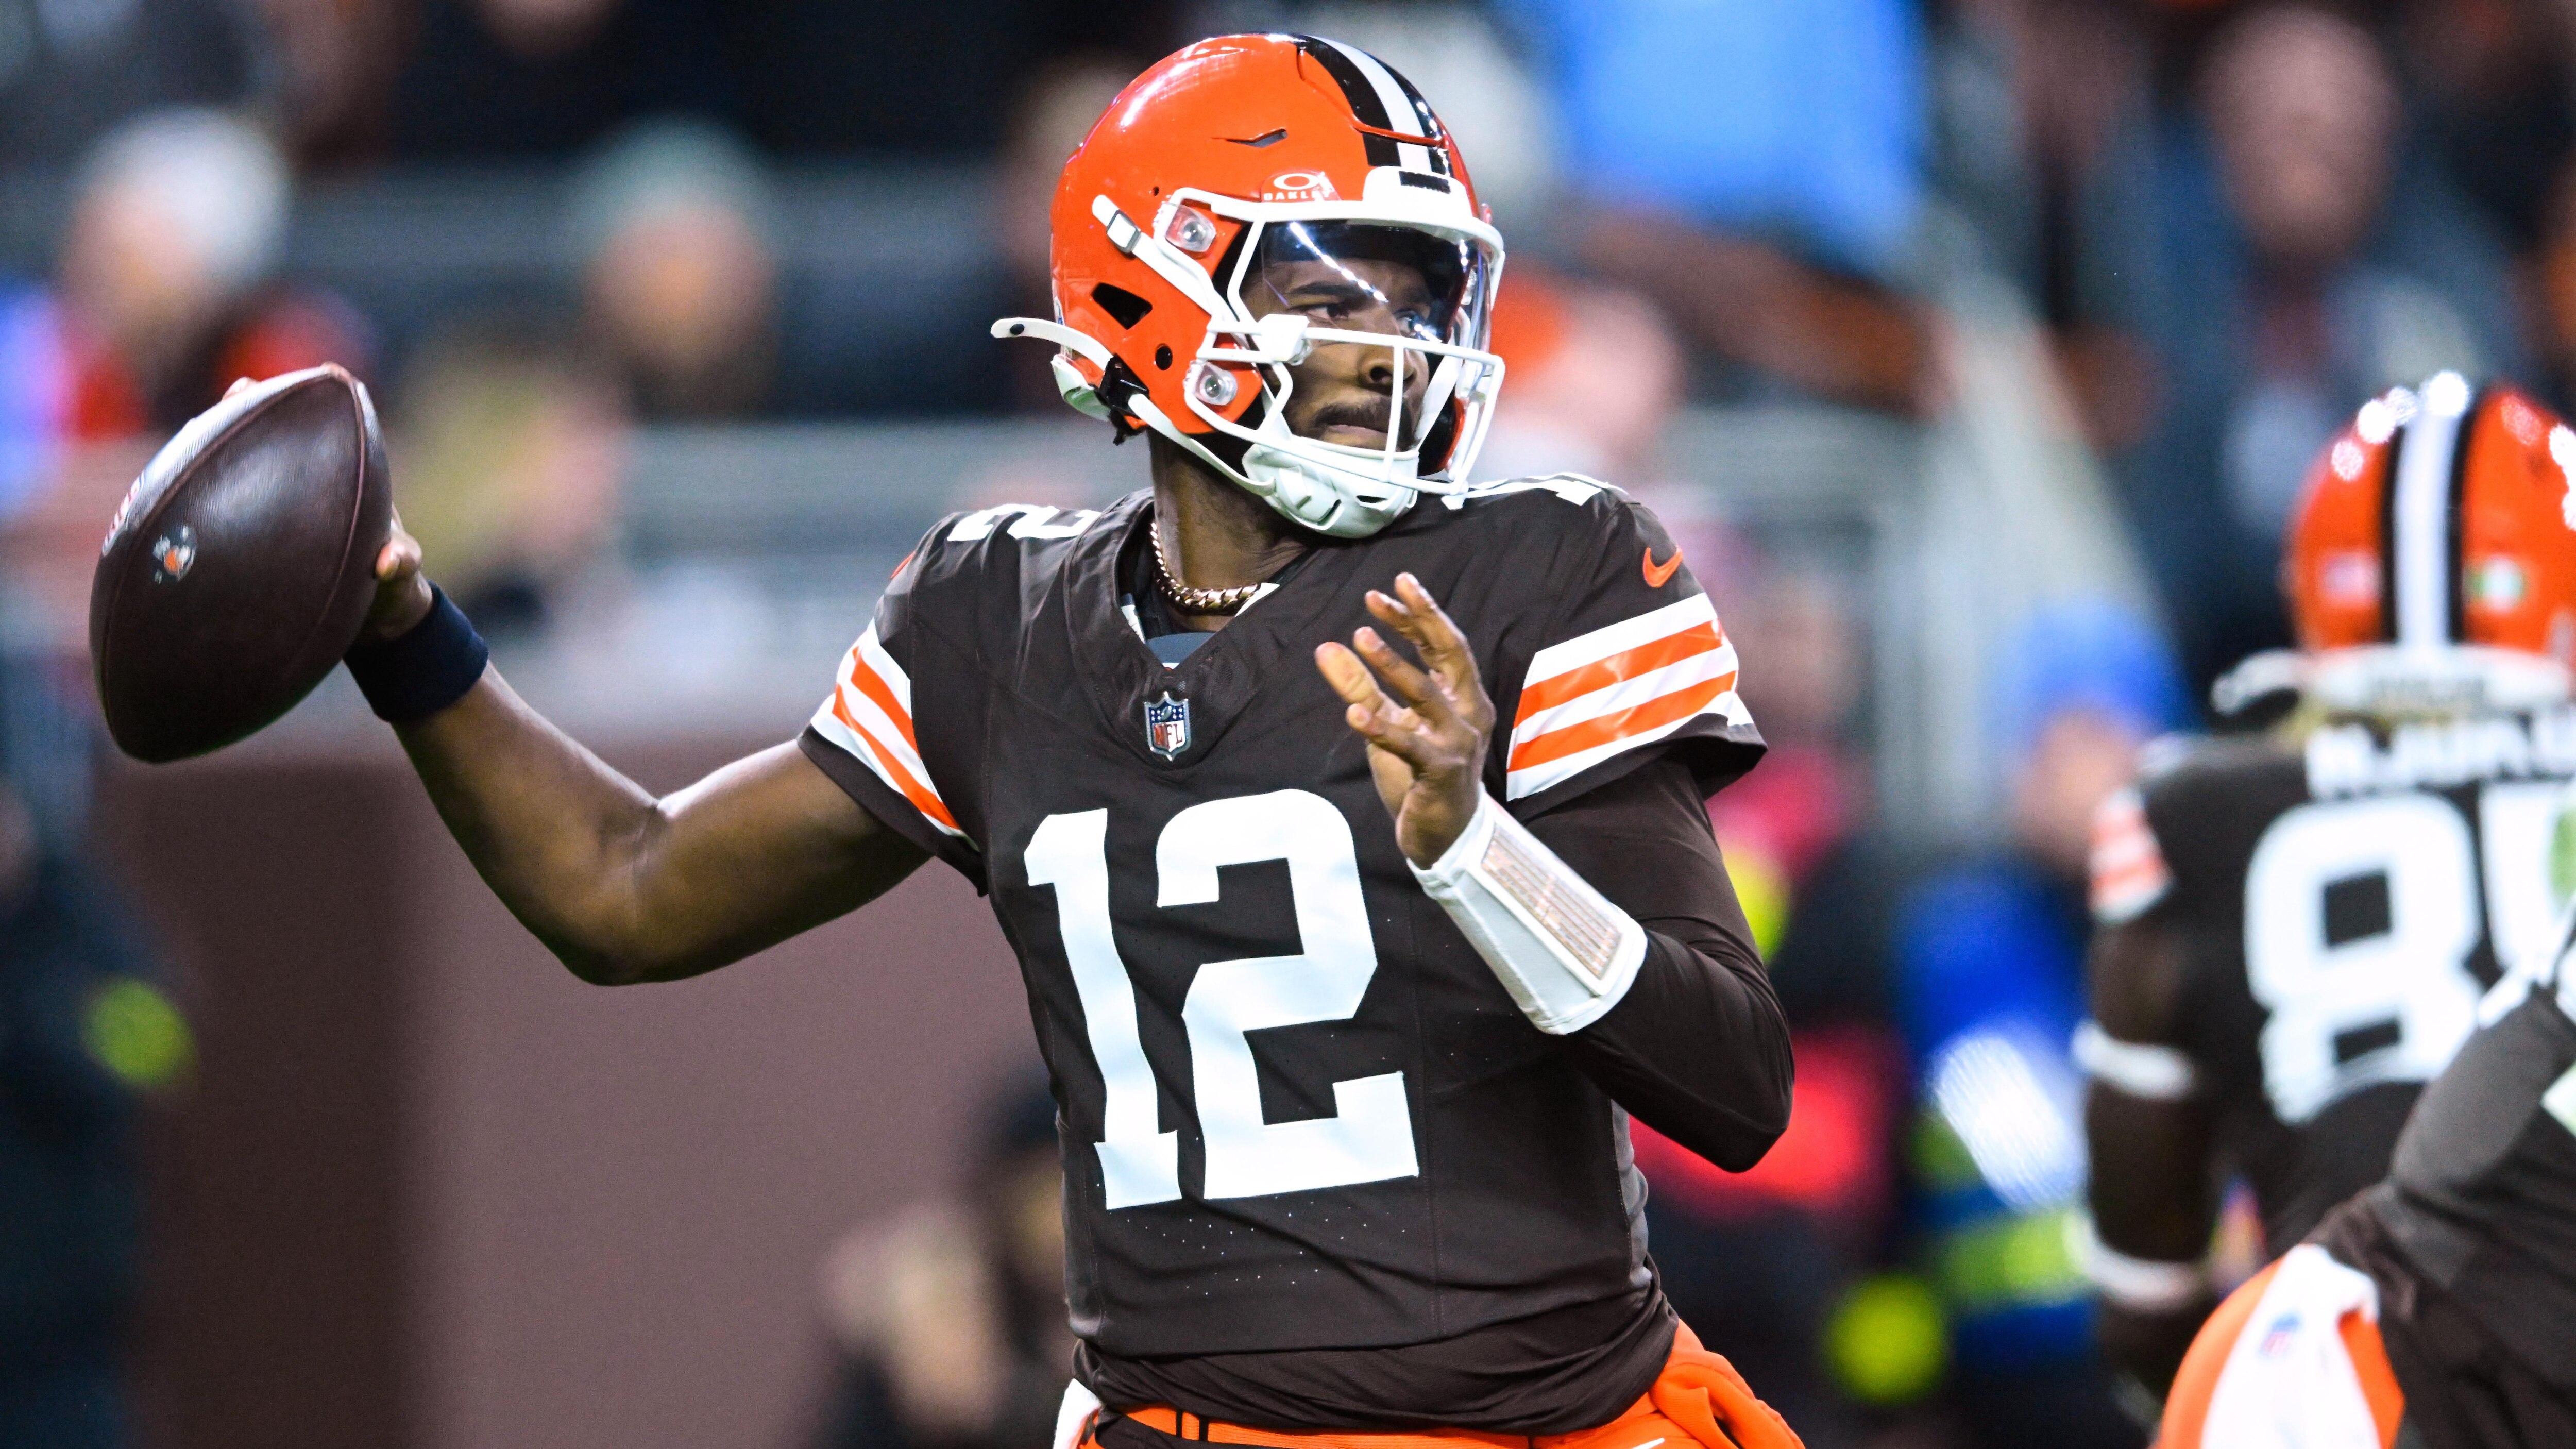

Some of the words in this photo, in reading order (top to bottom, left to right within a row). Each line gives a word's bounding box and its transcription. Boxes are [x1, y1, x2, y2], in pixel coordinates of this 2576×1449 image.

[1263, 190, 1333, 201] OAKLEY
[1153, 723, 1183, 749] NFL
[1024, 788, 1419, 1210] 12
